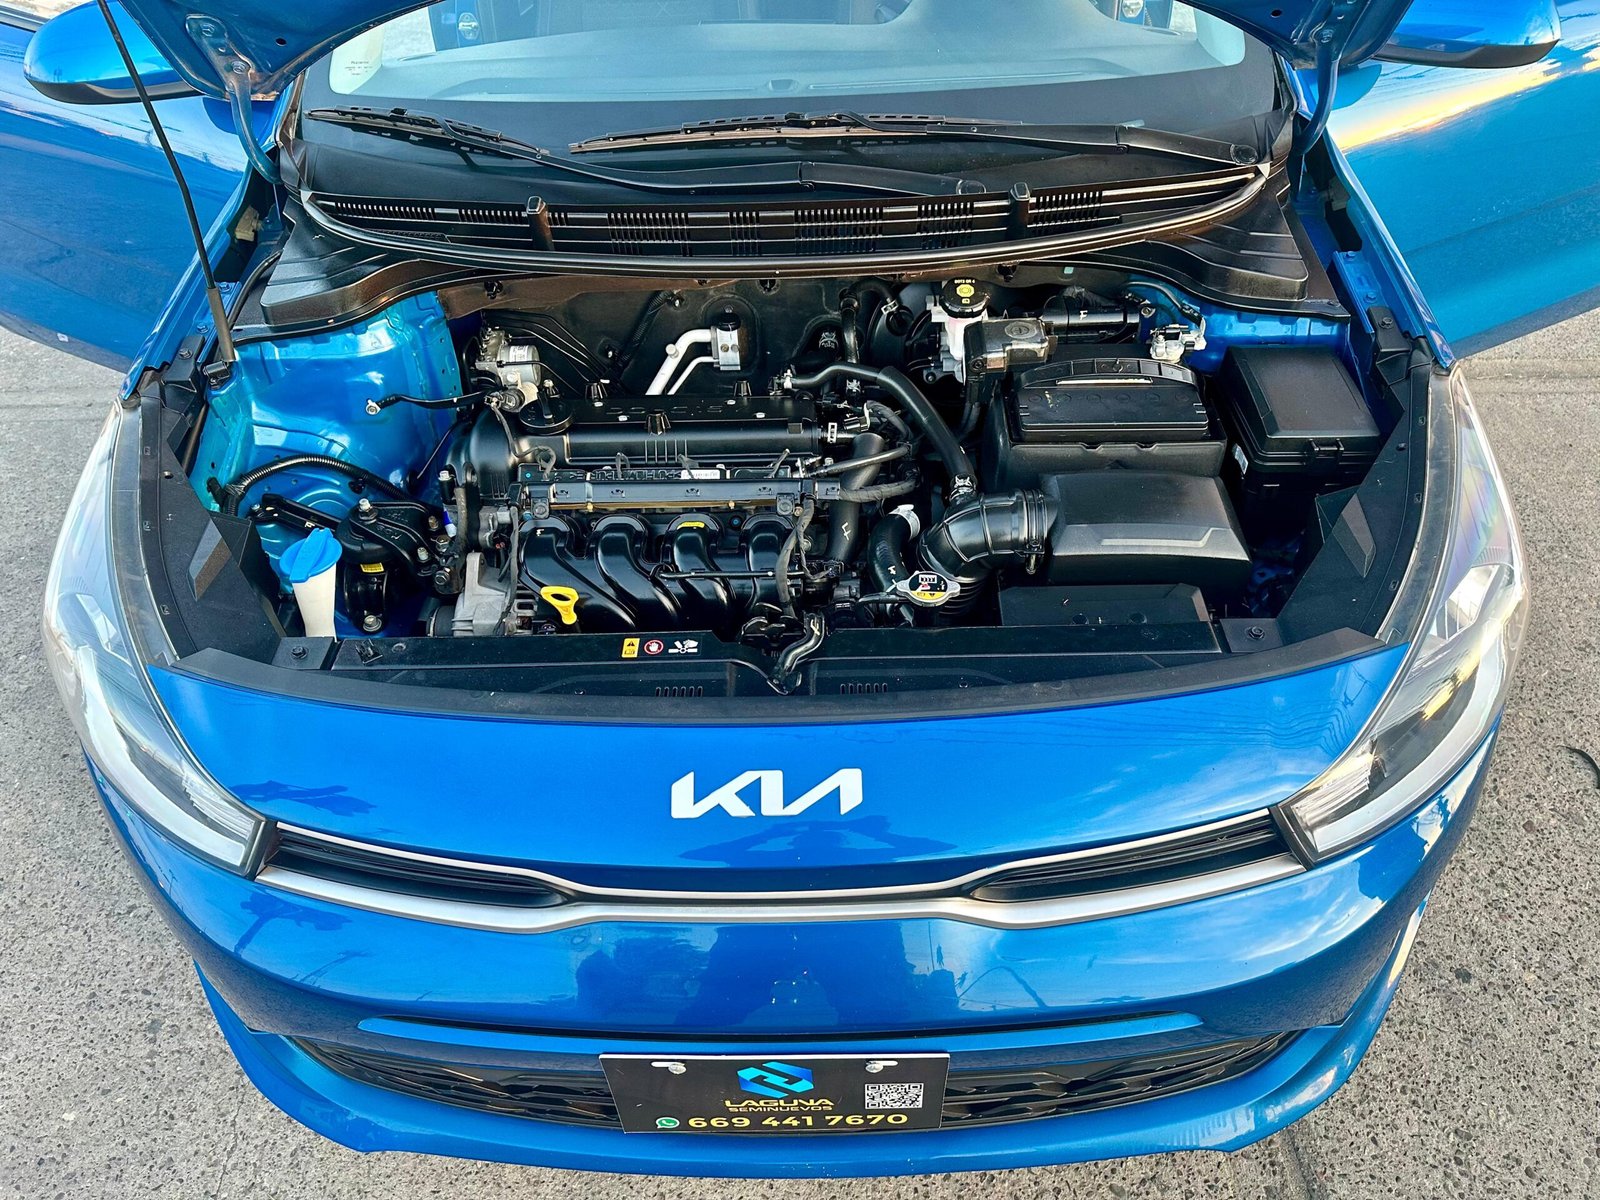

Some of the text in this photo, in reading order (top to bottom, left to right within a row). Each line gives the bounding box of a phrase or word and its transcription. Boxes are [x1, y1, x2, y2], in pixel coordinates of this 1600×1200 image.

[671, 768, 863, 819] KIA
[724, 1098, 835, 1107] LAGUNA
[688, 1113, 909, 1128] 669 441 7670
